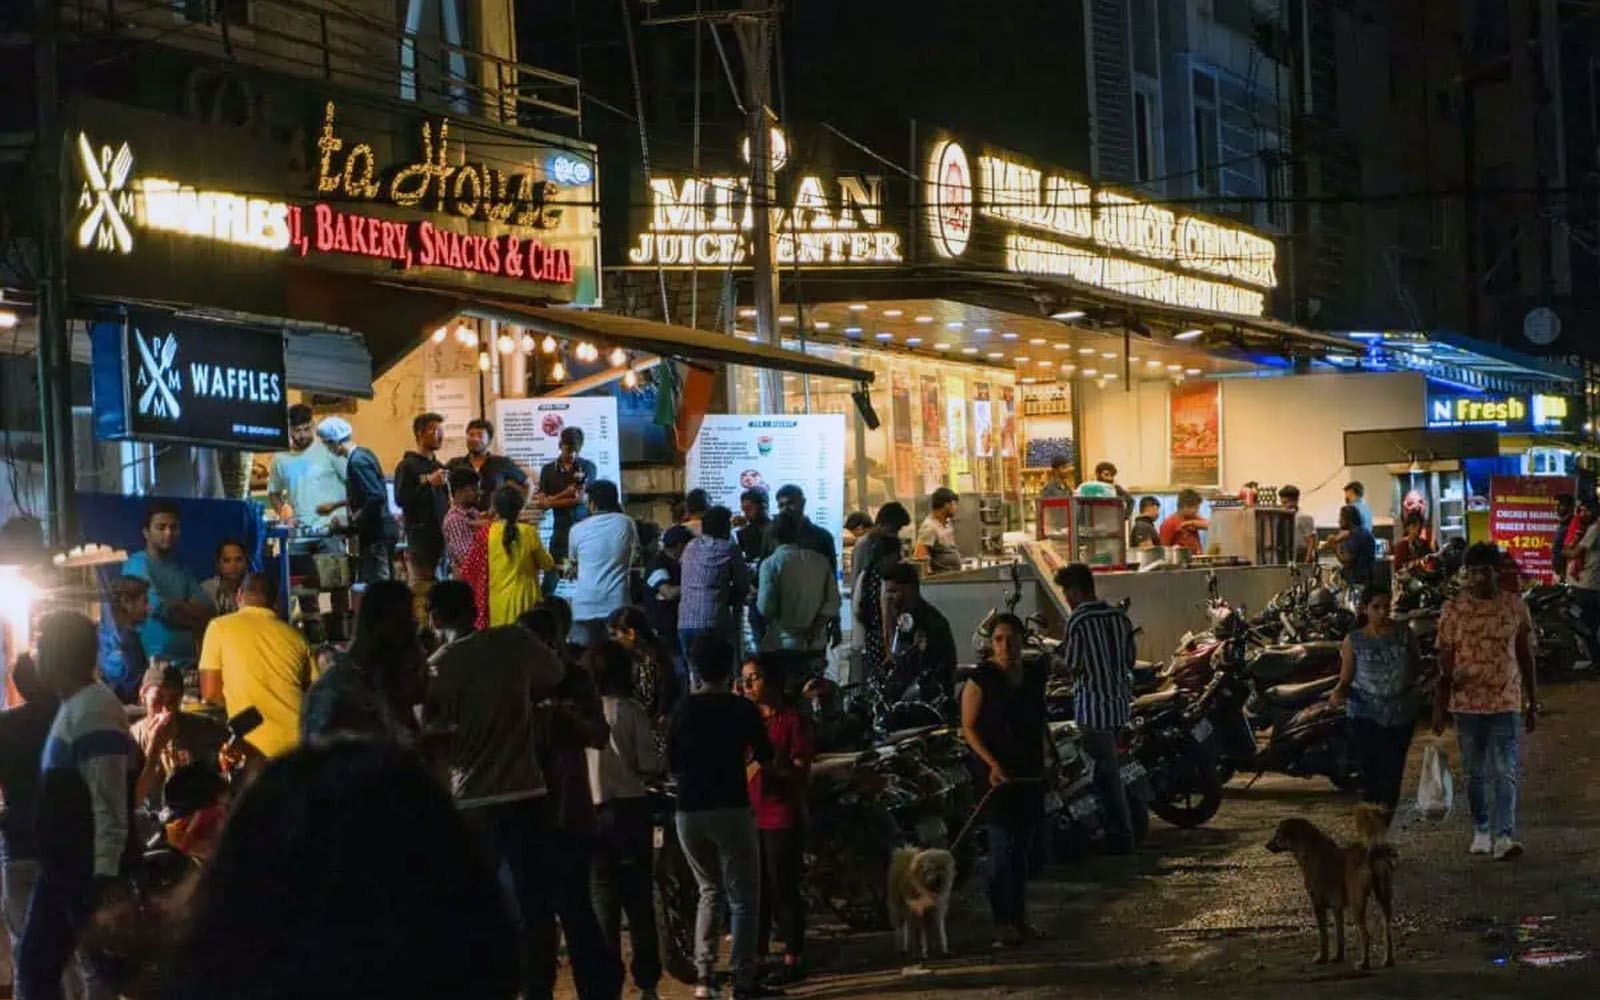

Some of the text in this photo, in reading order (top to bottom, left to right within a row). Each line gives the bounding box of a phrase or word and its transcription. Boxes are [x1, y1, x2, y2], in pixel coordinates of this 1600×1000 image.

[315, 203, 413, 269] BAKERY,
[420, 222, 500, 274] SNACKS
[505, 237, 524, 277] &
[529, 239, 574, 283] CHAI
[629, 231, 903, 263] JUICE ENTER
[190, 361, 281, 405] WAFFLES
[1434, 400, 1451, 420] N
[1457, 397, 1525, 420] Fresh
